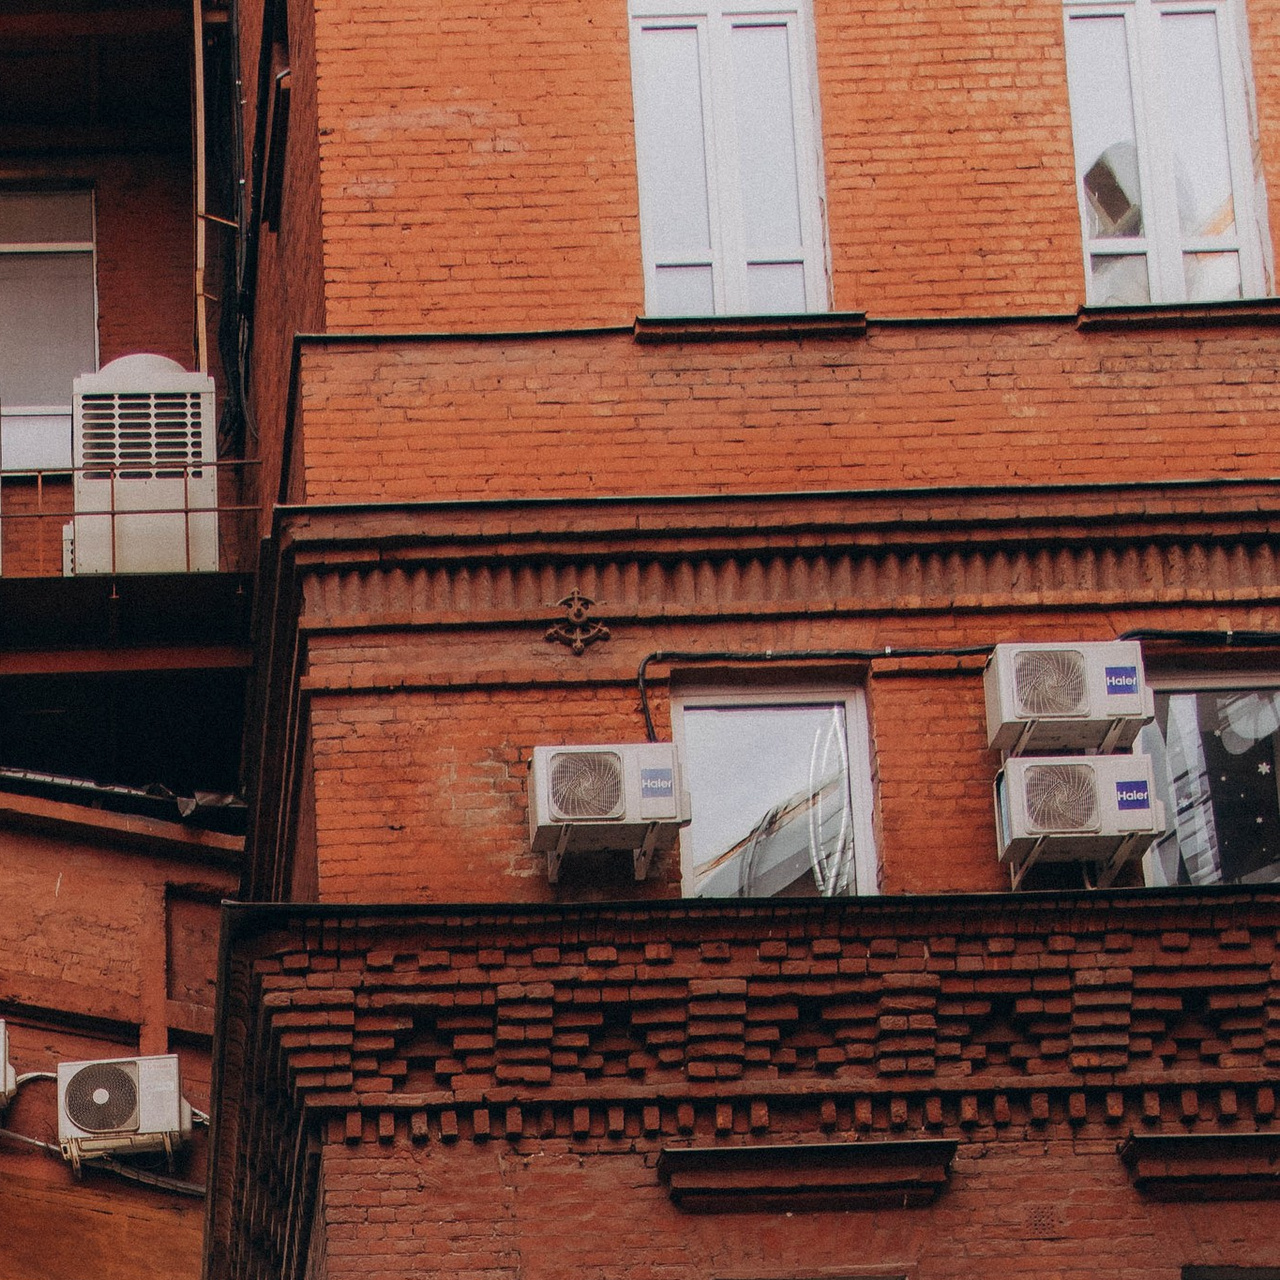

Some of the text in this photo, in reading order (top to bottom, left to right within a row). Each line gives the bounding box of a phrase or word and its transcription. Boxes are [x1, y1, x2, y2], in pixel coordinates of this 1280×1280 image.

[1106, 675, 1136, 686] Haier
[641, 778, 672, 788] Haier
[1117, 790, 1148, 801] Haier
